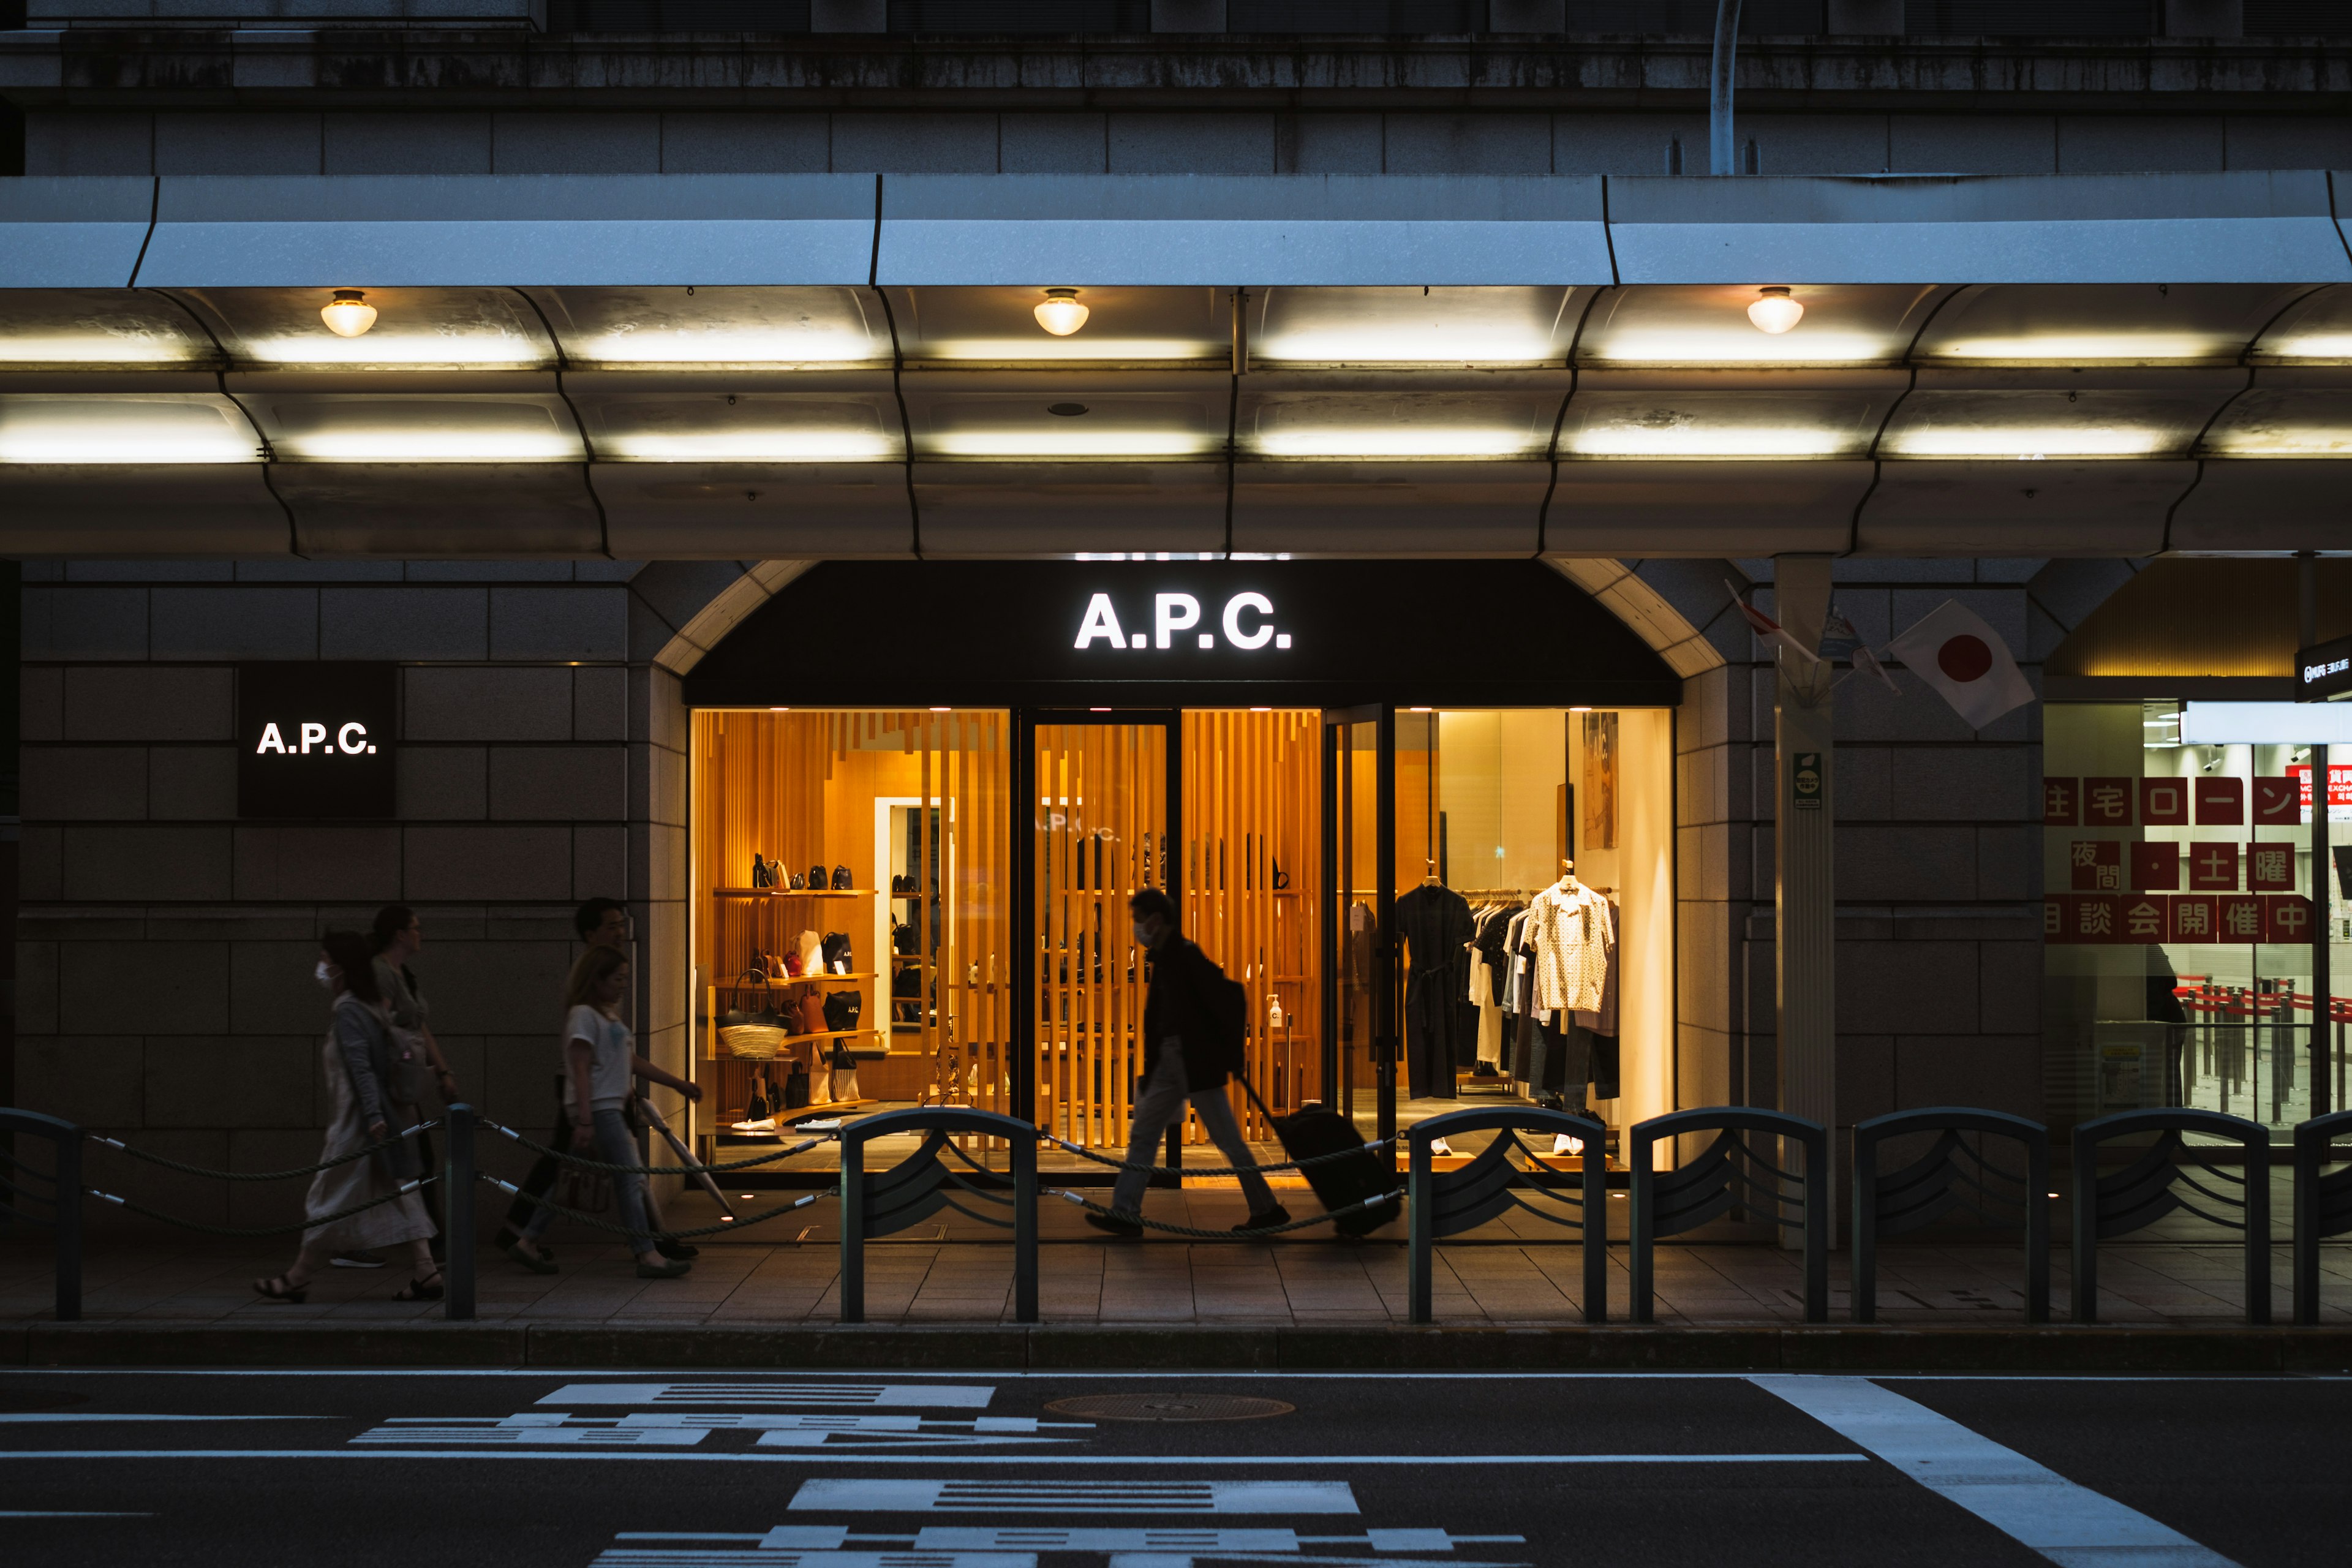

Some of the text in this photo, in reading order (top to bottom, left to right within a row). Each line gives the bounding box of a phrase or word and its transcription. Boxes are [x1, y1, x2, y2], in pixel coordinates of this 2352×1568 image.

[1074, 592, 1292, 650] A.P.C.
[256, 722, 377, 755] A.P.C.
[2044, 785, 2291, 818] 住宅ローン
